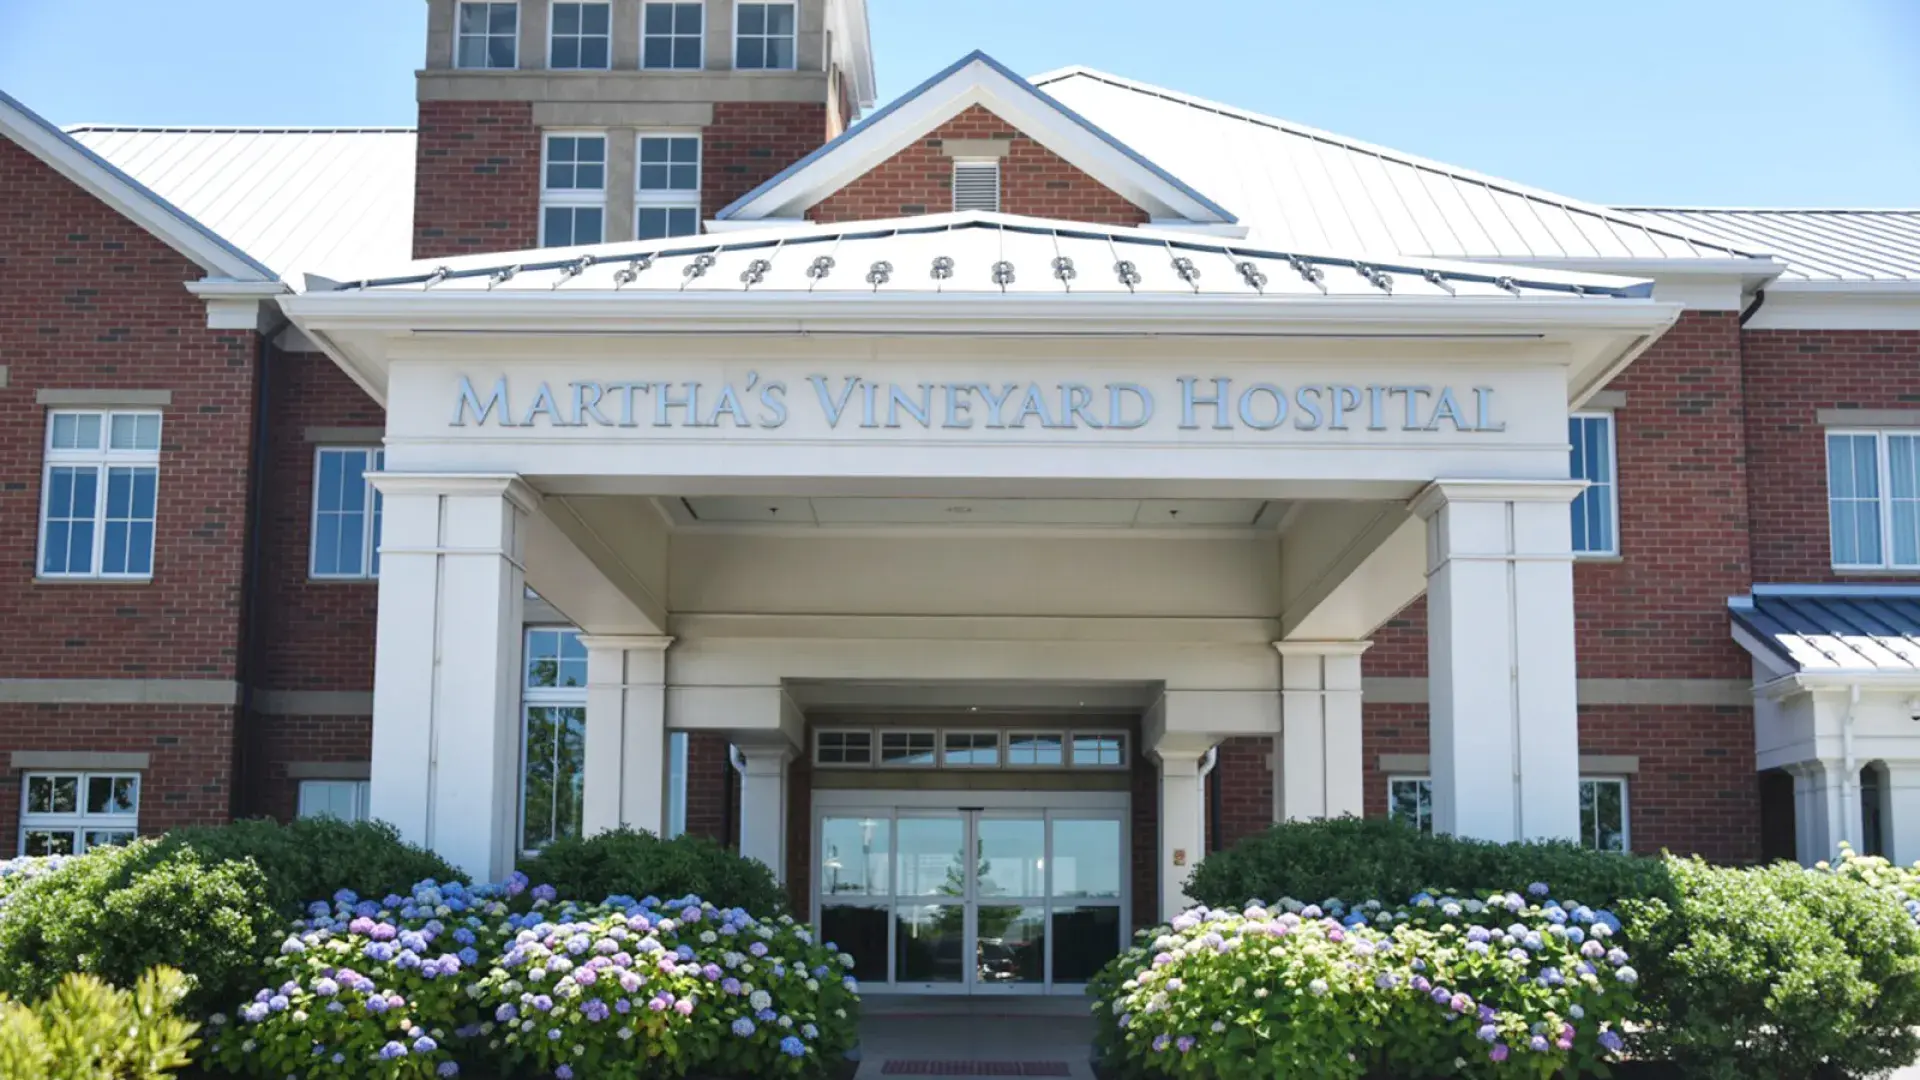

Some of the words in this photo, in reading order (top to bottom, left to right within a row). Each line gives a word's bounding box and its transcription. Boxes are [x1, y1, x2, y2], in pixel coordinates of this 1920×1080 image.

[449, 371, 788, 428] MARTHA'S
[806, 374, 1154, 429] VINEYARD
[1176, 376, 1506, 433] HOSPITAL
